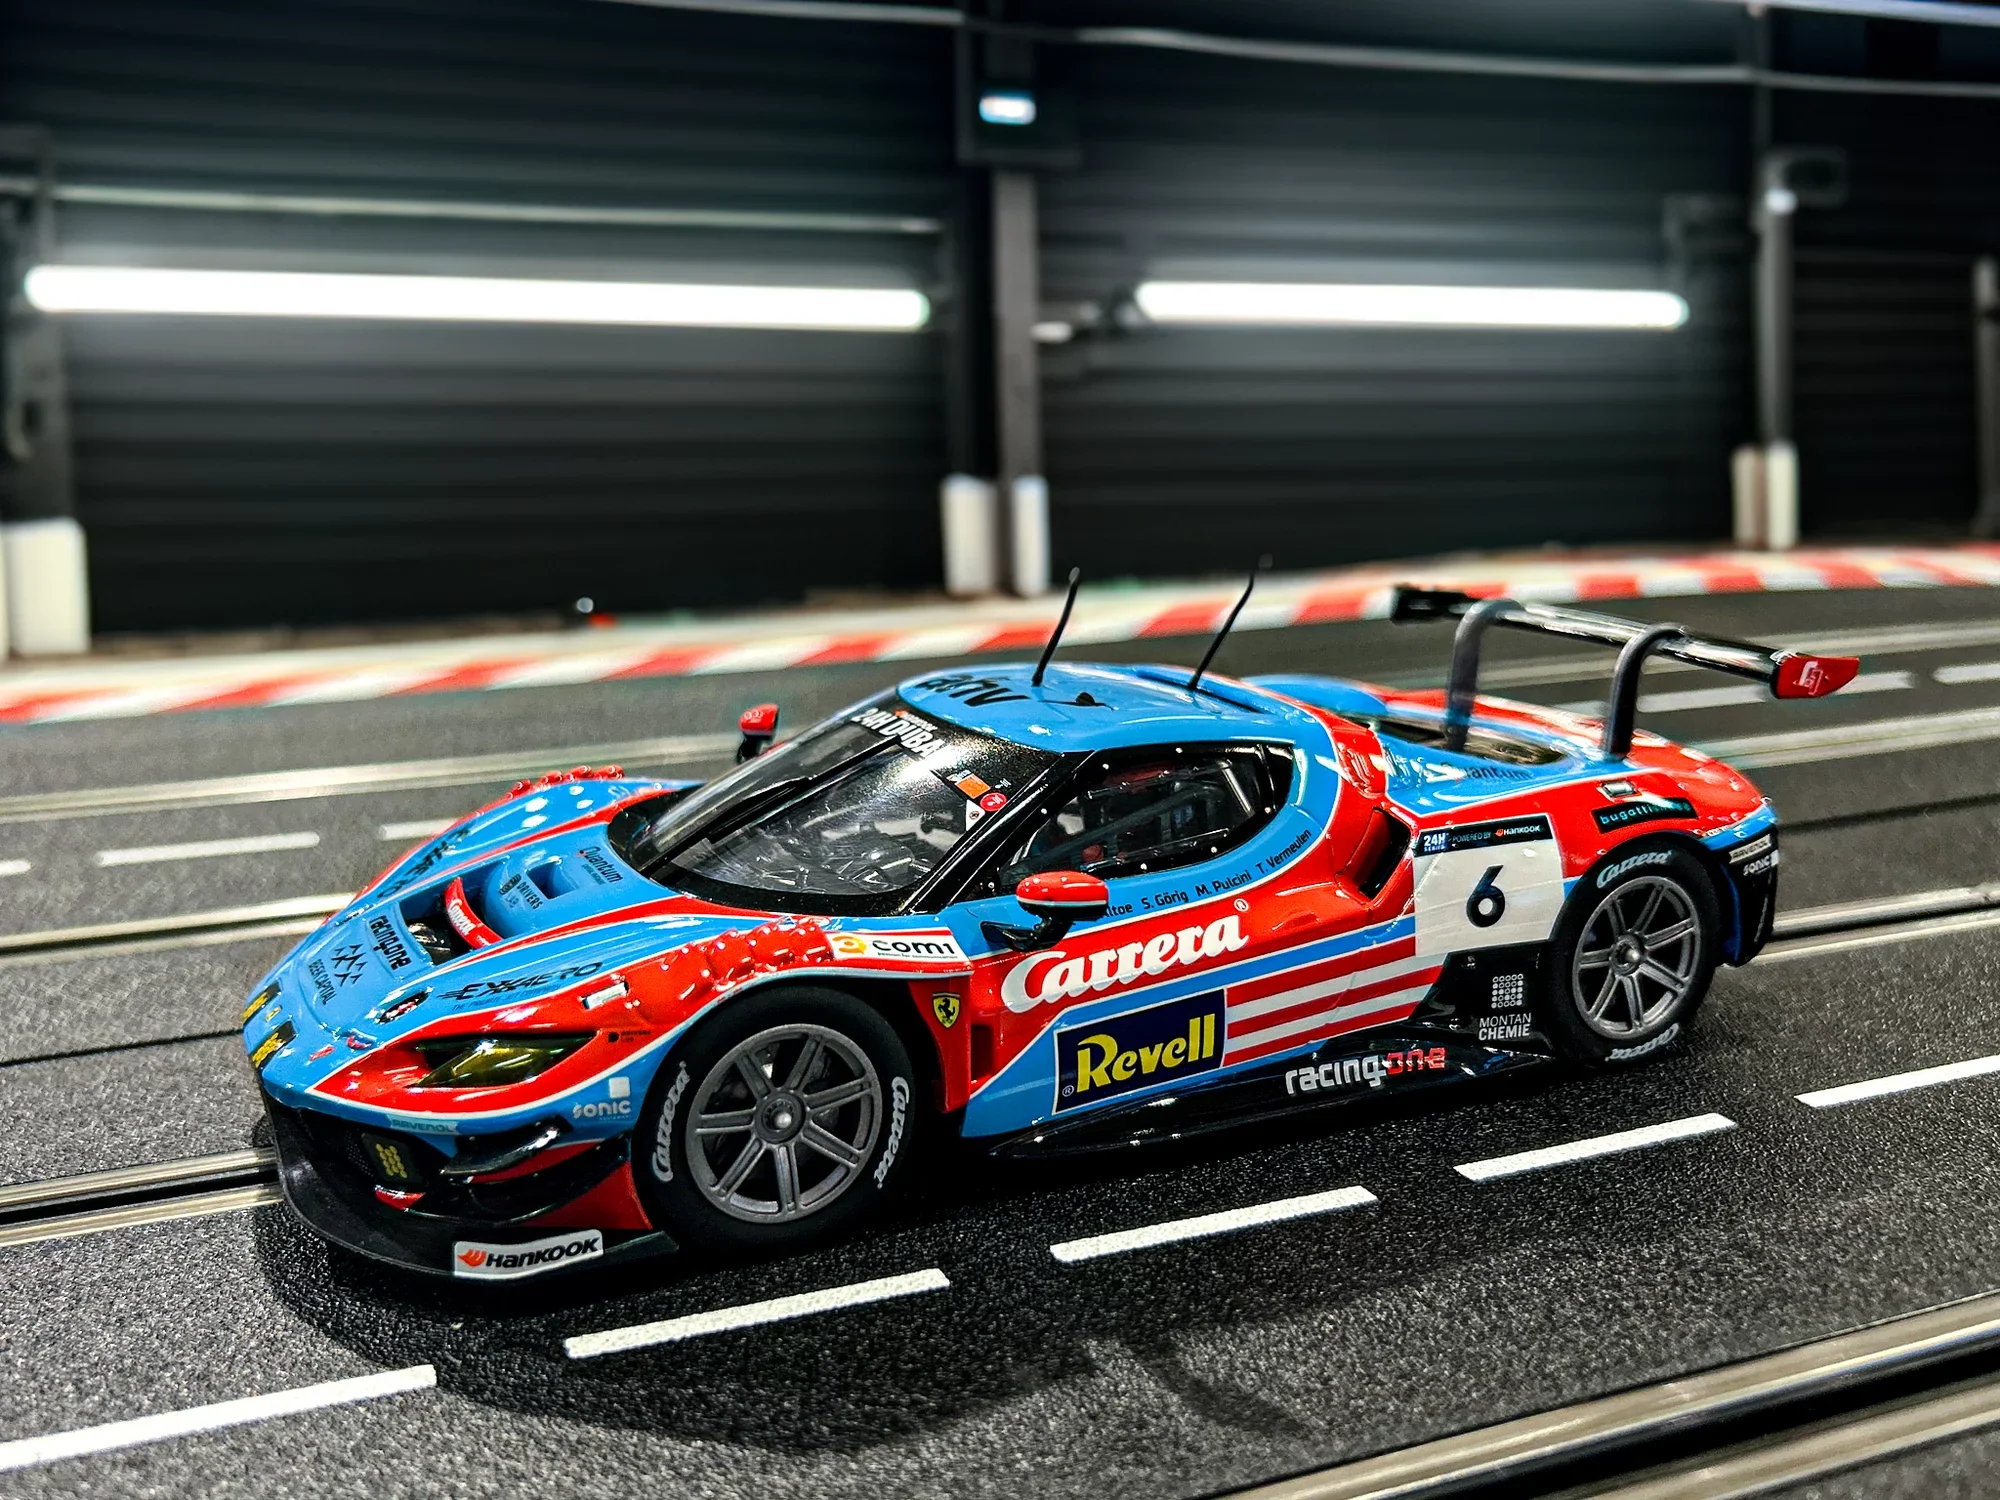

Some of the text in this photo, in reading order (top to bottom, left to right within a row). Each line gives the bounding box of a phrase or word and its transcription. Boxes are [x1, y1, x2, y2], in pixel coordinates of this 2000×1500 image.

[1423, 832, 1446, 847] 24H
[1141, 897, 1155, 909] S.
[1155, 890, 1189, 907] Görig
[1195, 886, 1212, 897] M.
[1212, 869, 1252, 892] Pulcini
[1256, 863, 1268, 874] T.
[1266, 828, 1312, 868] Vermeulen
[1597, 851, 1671, 889] Carrera
[517, 881, 543, 909] DRIVERS
[1466, 864, 1506, 928] 6
[1001, 911, 1249, 1013] Carrera
[1478, 1023, 1531, 1041] CHEMIE
[1479, 1013, 1531, 1028] MONTAN
[1076, 1013, 1215, 1092] Revell
[652, 1064, 690, 1182] Carrera
